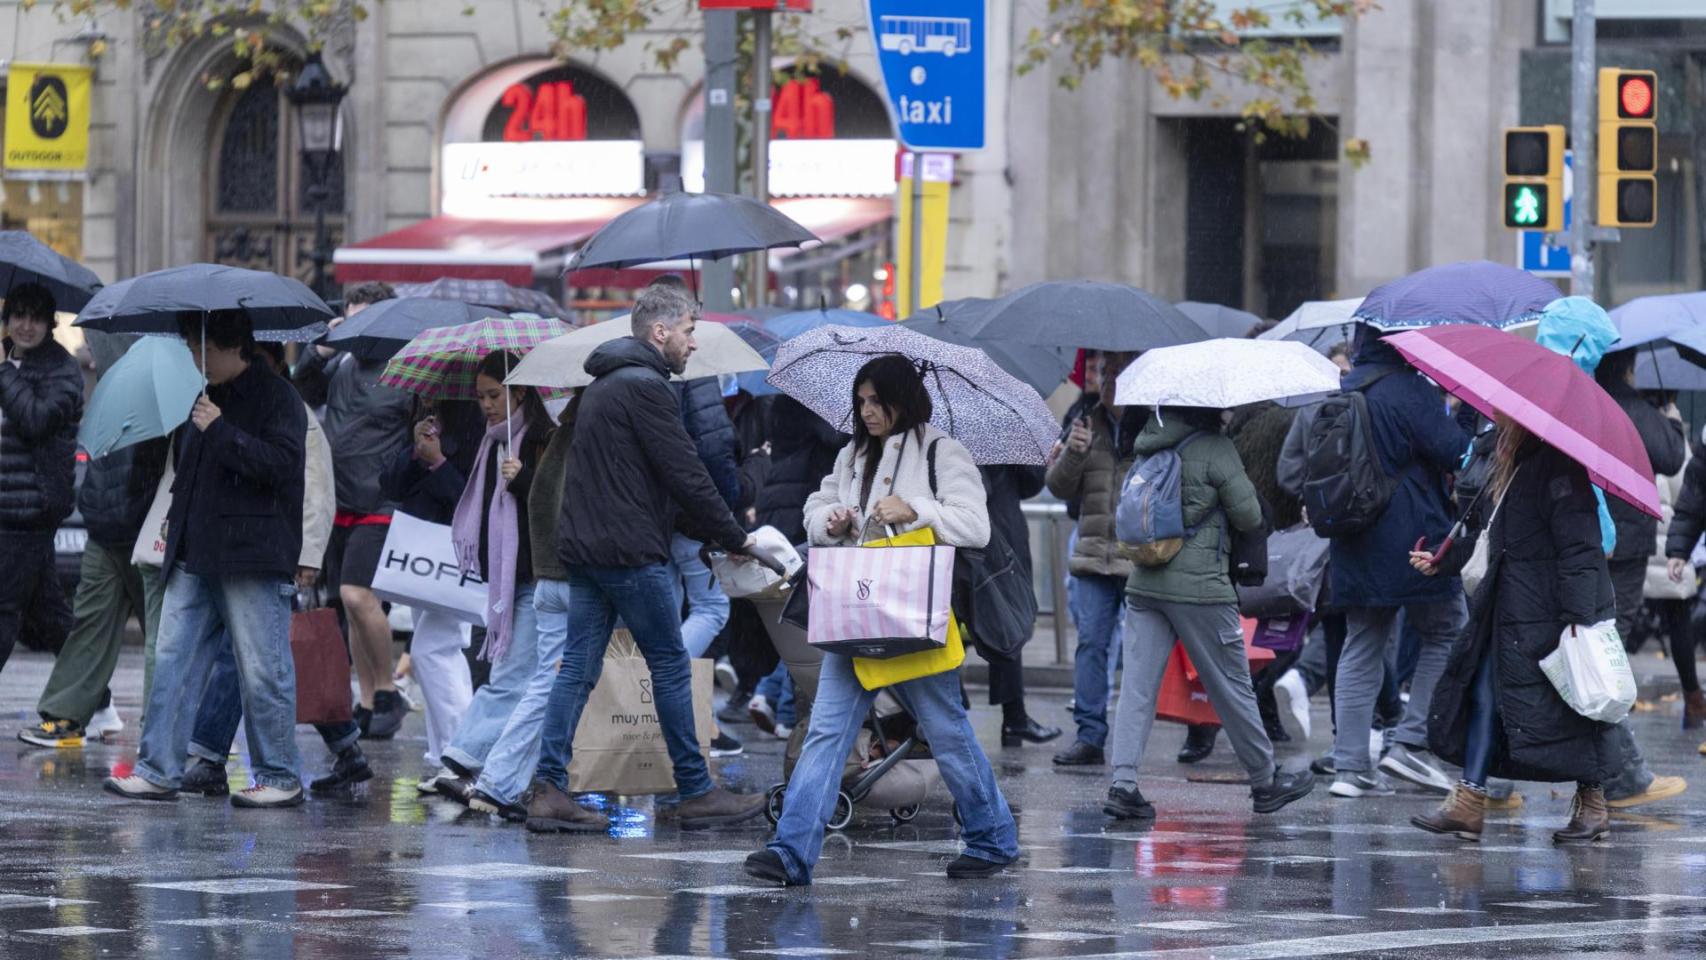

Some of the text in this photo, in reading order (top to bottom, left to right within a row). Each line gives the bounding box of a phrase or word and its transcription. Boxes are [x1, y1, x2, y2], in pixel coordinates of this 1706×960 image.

[502, 80, 587, 141] 24h
[771, 77, 835, 139] 4h
[900, 95, 951, 124] taxi
[385, 549, 483, 587] HOFF
[611, 714, 639, 726] muy
